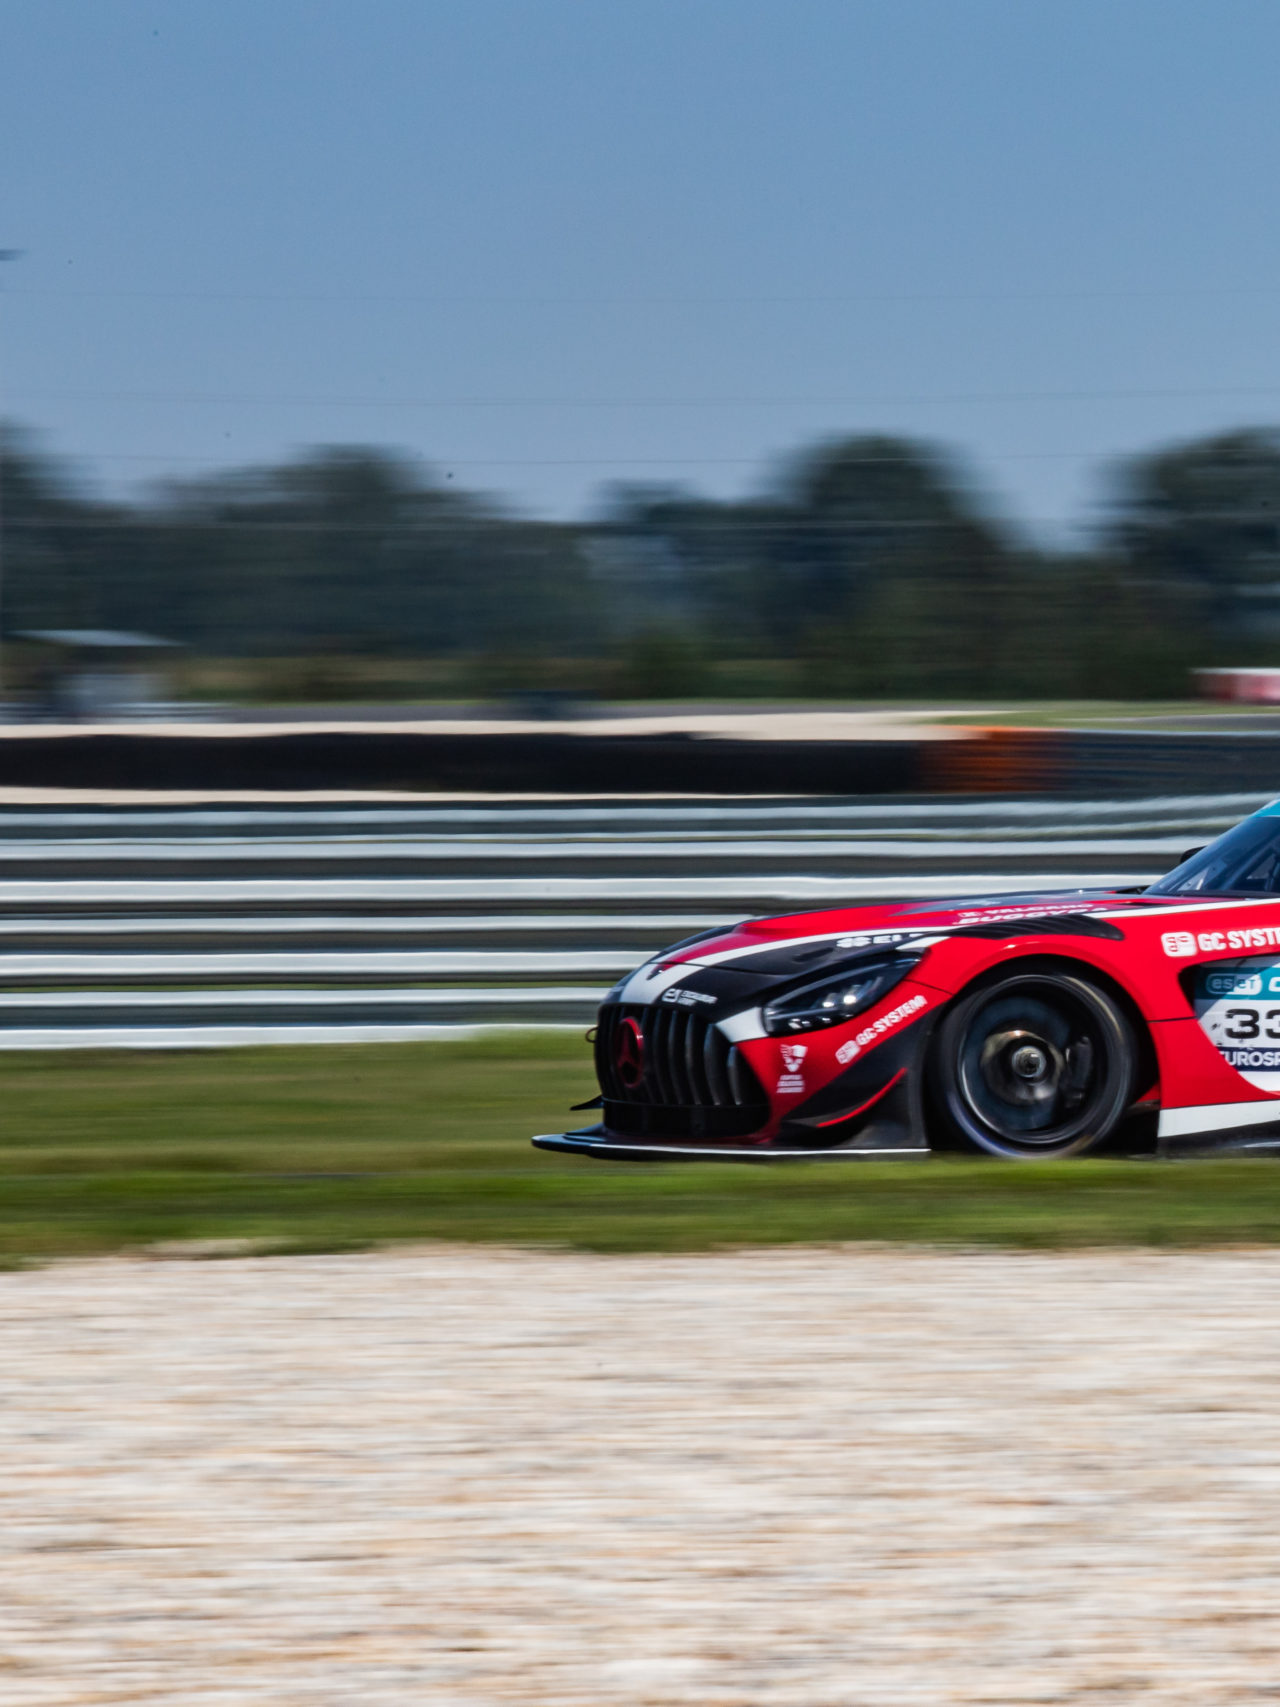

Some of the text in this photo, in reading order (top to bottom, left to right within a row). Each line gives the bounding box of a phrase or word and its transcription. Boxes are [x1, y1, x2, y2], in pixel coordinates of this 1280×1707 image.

[1197, 932, 1227, 951] GC
[856, 994, 928, 1046] GC SYSTEM
